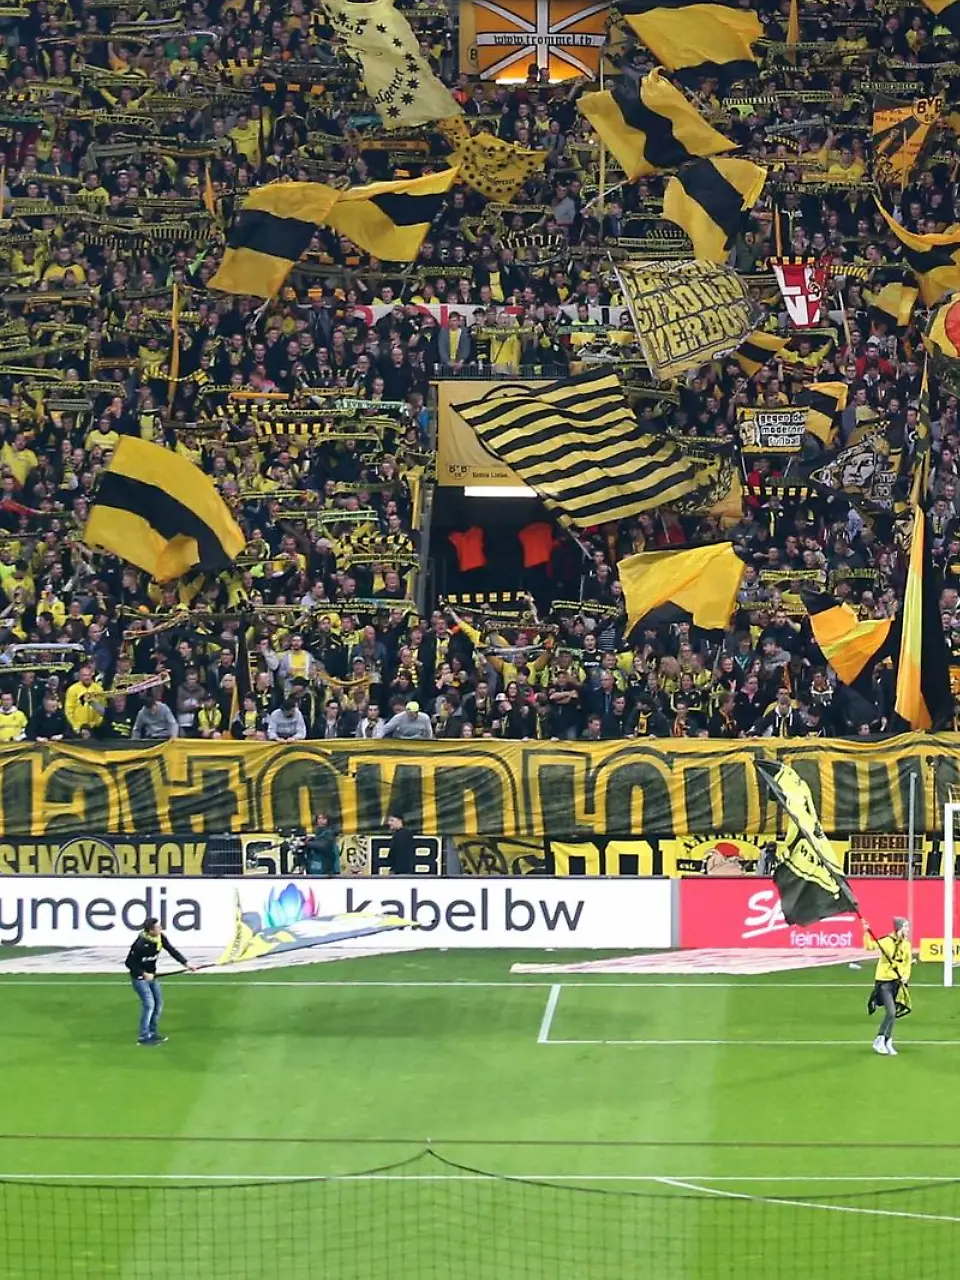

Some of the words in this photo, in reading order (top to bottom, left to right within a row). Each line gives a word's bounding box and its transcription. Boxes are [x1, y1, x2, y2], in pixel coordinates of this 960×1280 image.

[758, 413, 791, 425] gegen
[346, 888, 489, 933] kabel
[506, 888, 585, 932] bw
[789, 930, 853, 947] feinkost
